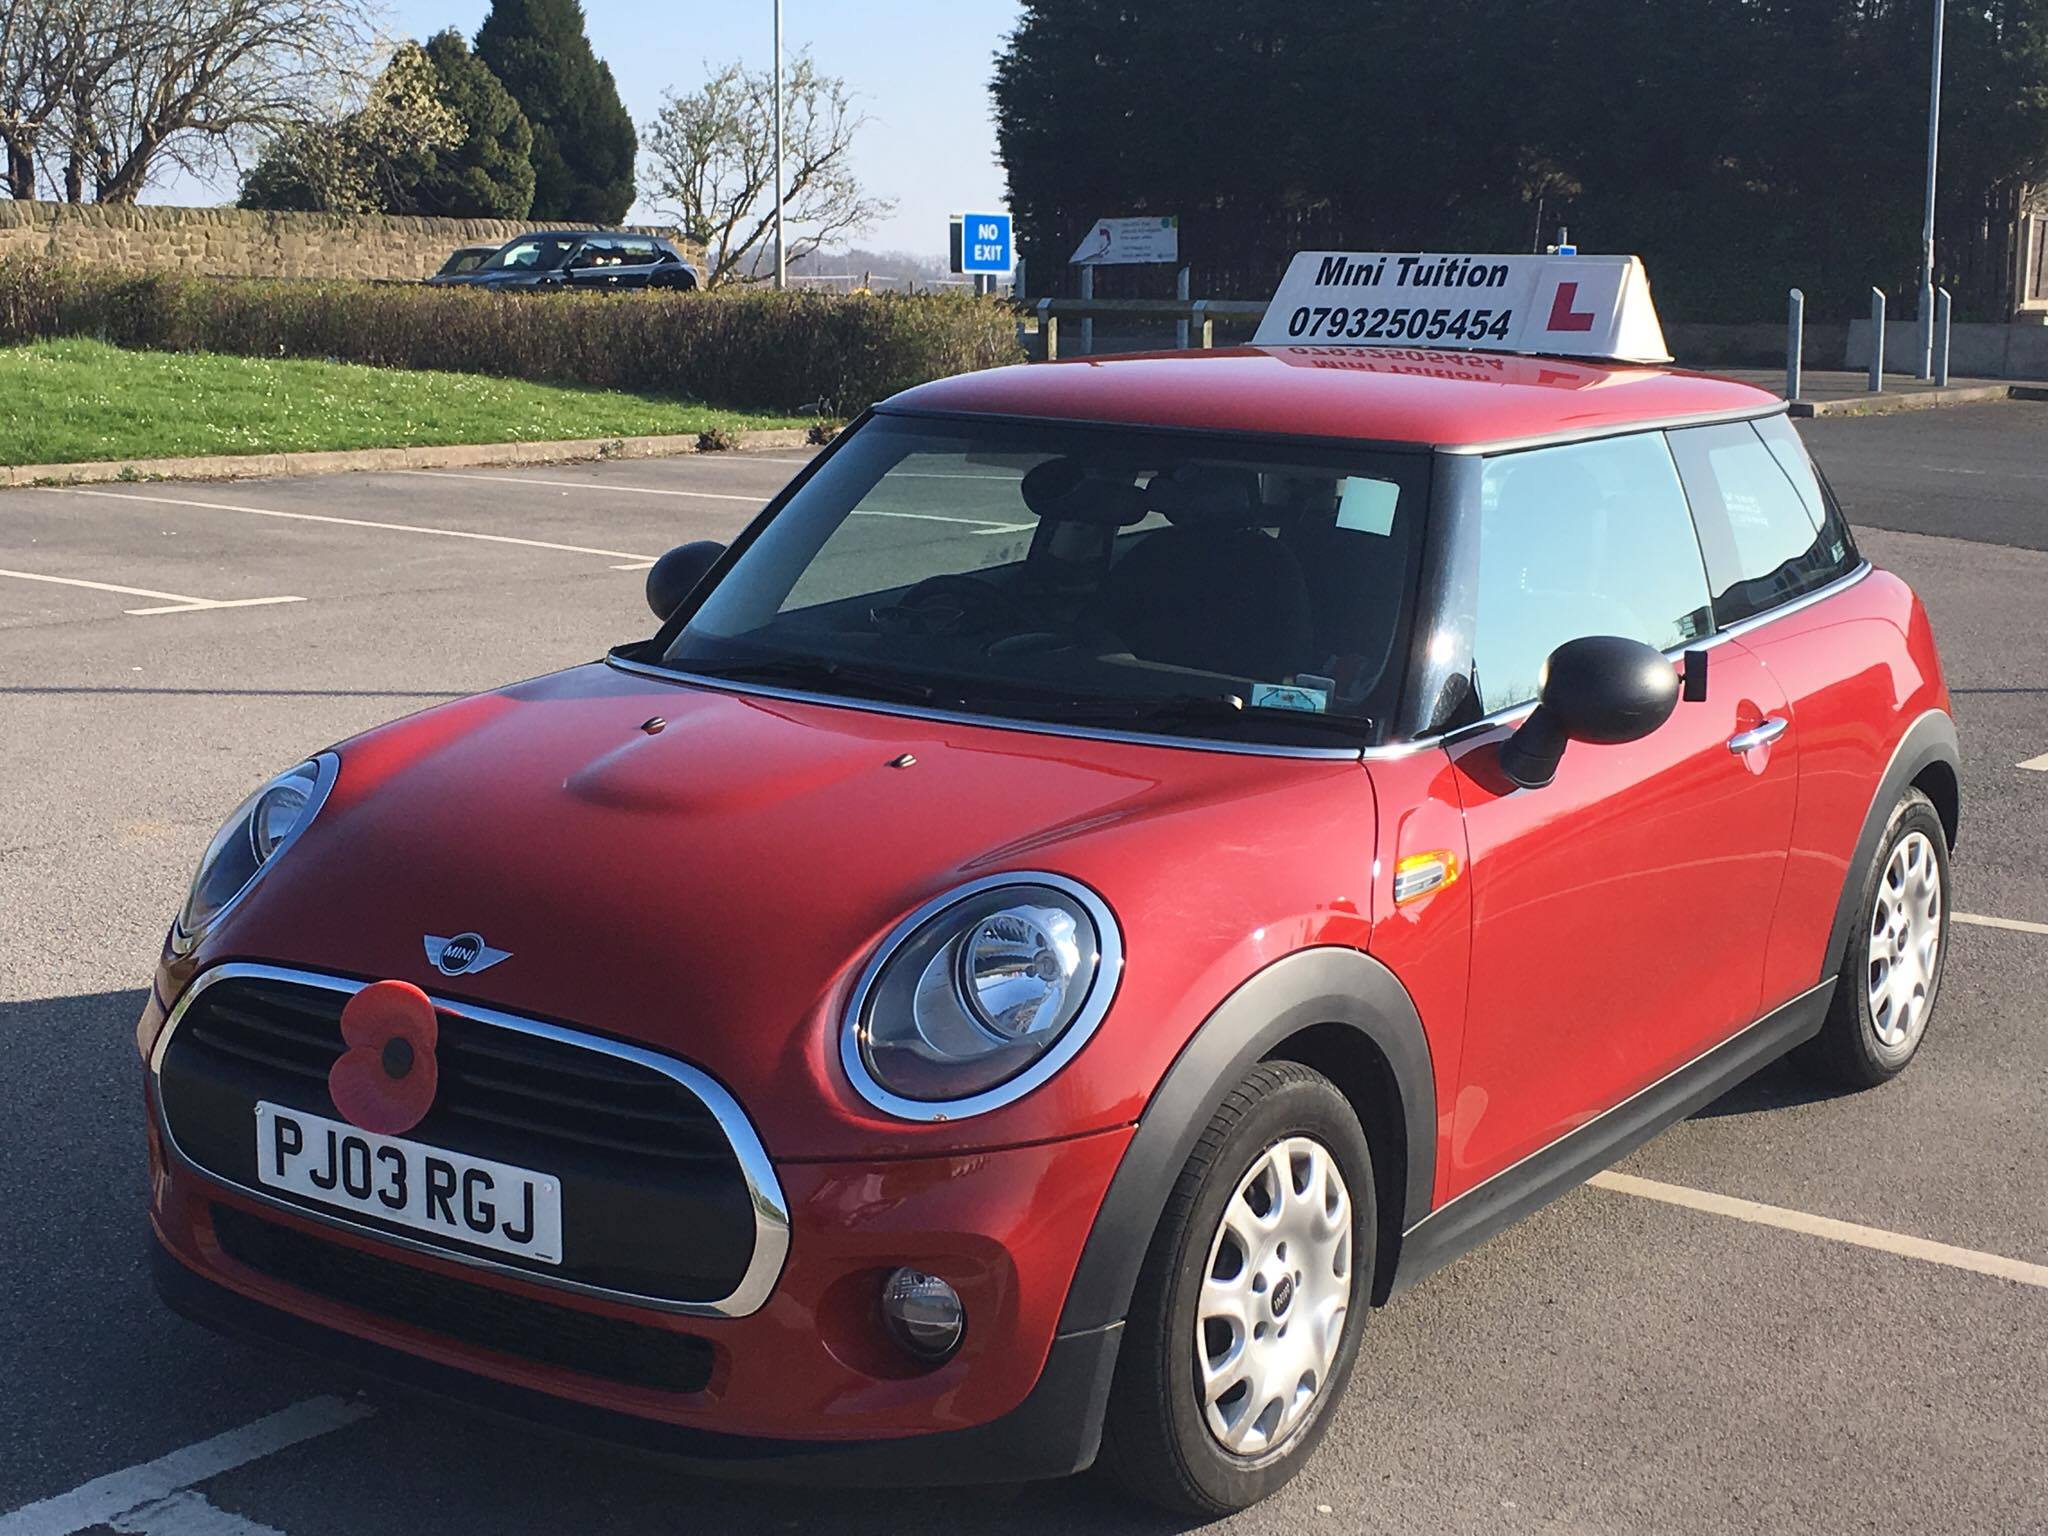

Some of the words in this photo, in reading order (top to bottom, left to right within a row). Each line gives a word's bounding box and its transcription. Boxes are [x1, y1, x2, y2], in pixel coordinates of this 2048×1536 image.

[978, 223, 999, 241] NO
[974, 244, 1003, 262] EXIT
[1314, 256, 1386, 287] Mini
[1396, 257, 1510, 288] Tuition
[1546, 282, 1595, 332] L
[1288, 306, 1513, 341] 07932505454
[443, 945, 476, 961] MINI
[274, 1114, 409, 1211] PJ03
[425, 1156, 534, 1245] RGJ
